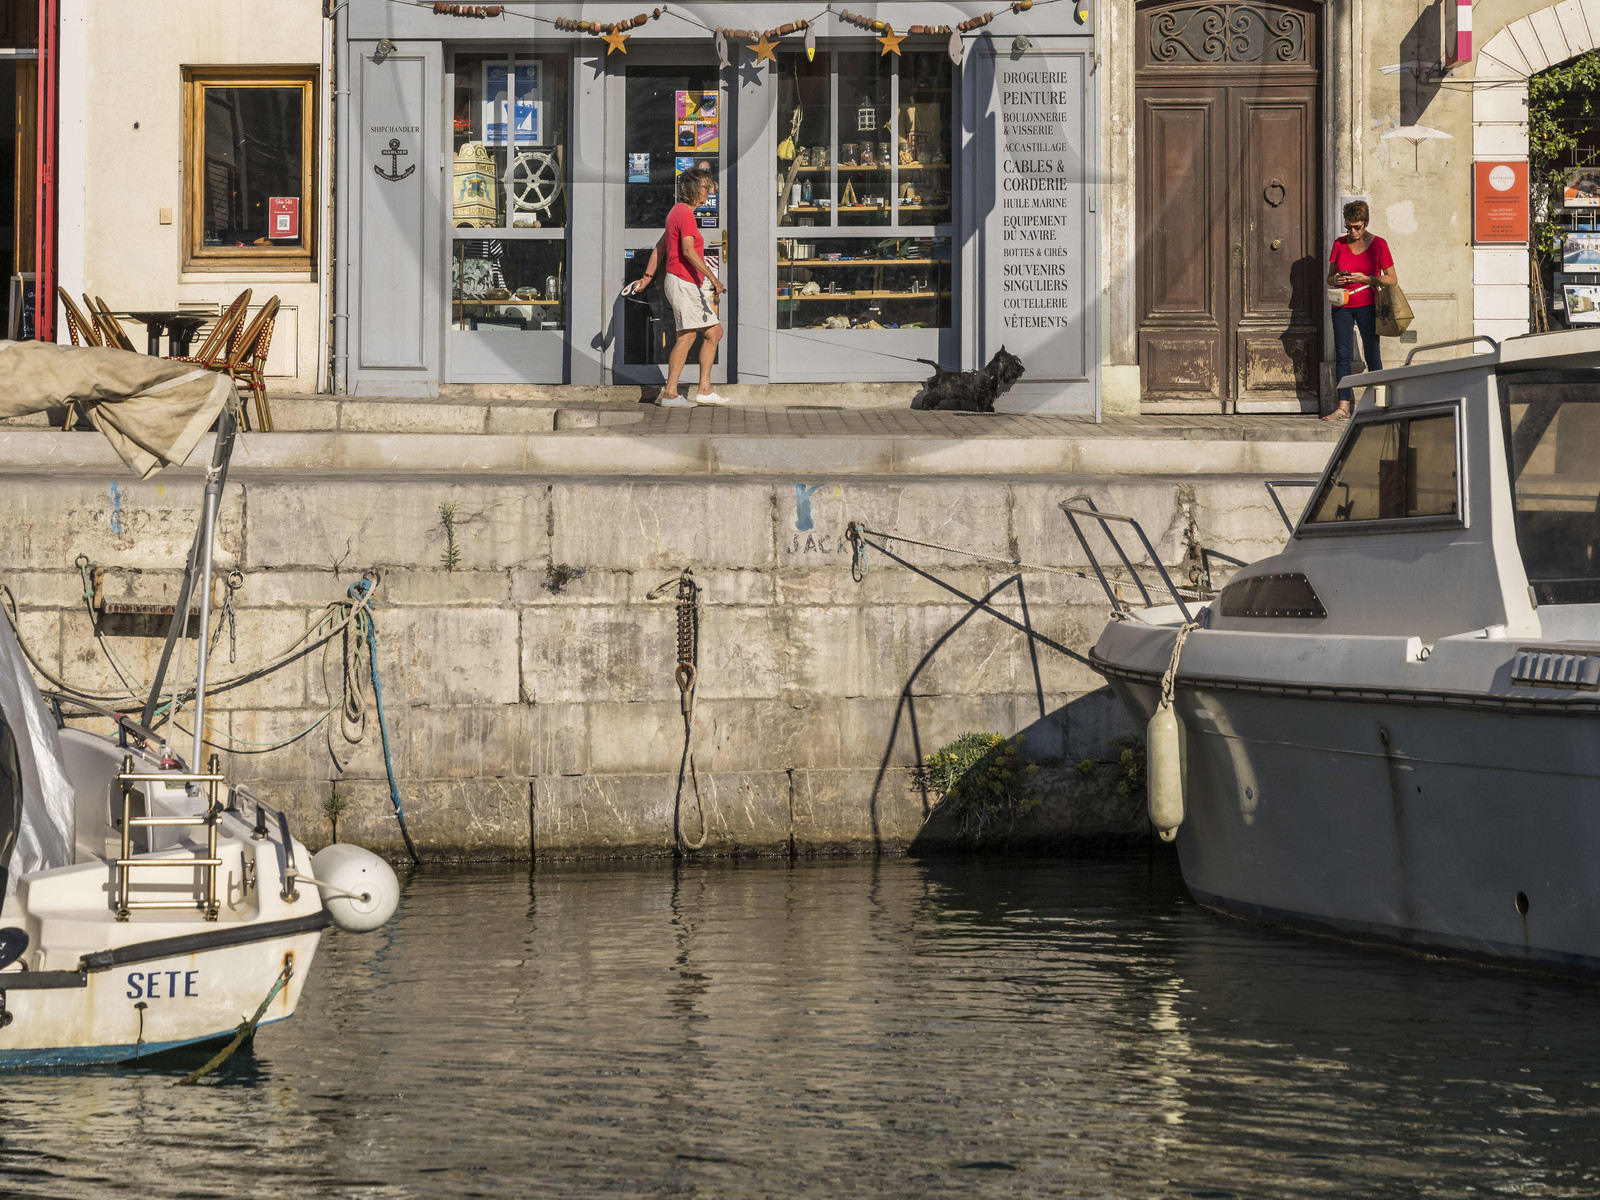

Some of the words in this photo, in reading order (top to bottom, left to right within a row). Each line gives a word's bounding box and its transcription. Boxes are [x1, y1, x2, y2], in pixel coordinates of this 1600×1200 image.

[1003, 71, 1068, 84] DROGUERIE
[1003, 91, 1067, 105] PEINTURE
[1003, 112, 1068, 123] BOULONNERIE
[1003, 125, 1010, 136] &
[1012, 125, 1054, 136] VISSERIE
[1003, 142, 1067, 153] ACCASTILLAGE
[1003, 159, 1053, 174] CABLES
[1056, 158, 1065, 173] &
[1003, 177, 1068, 192] CORDERIE
[1003, 198, 1030, 209] HUILE
[1031, 198, 1068, 208] MARINE
[1003, 215, 1068, 229] EQUIPEMENT
[1003, 229, 1017, 241] DU
[1019, 229, 1057, 241] NAVIRE
[1003, 247, 1035, 257] BOTTES
[1036, 248, 1042, 257] &
[1043, 245, 1068, 257] CIRÉS
[1003, 263, 1066, 277] SOUVENIRS
[1003, 279, 1068, 292] SINGULIERS
[1003, 298, 1068, 309] COUTELLERIE
[1003, 313, 1068, 328] VÊTEMENTS
[126, 969, 199, 1000] SETE
